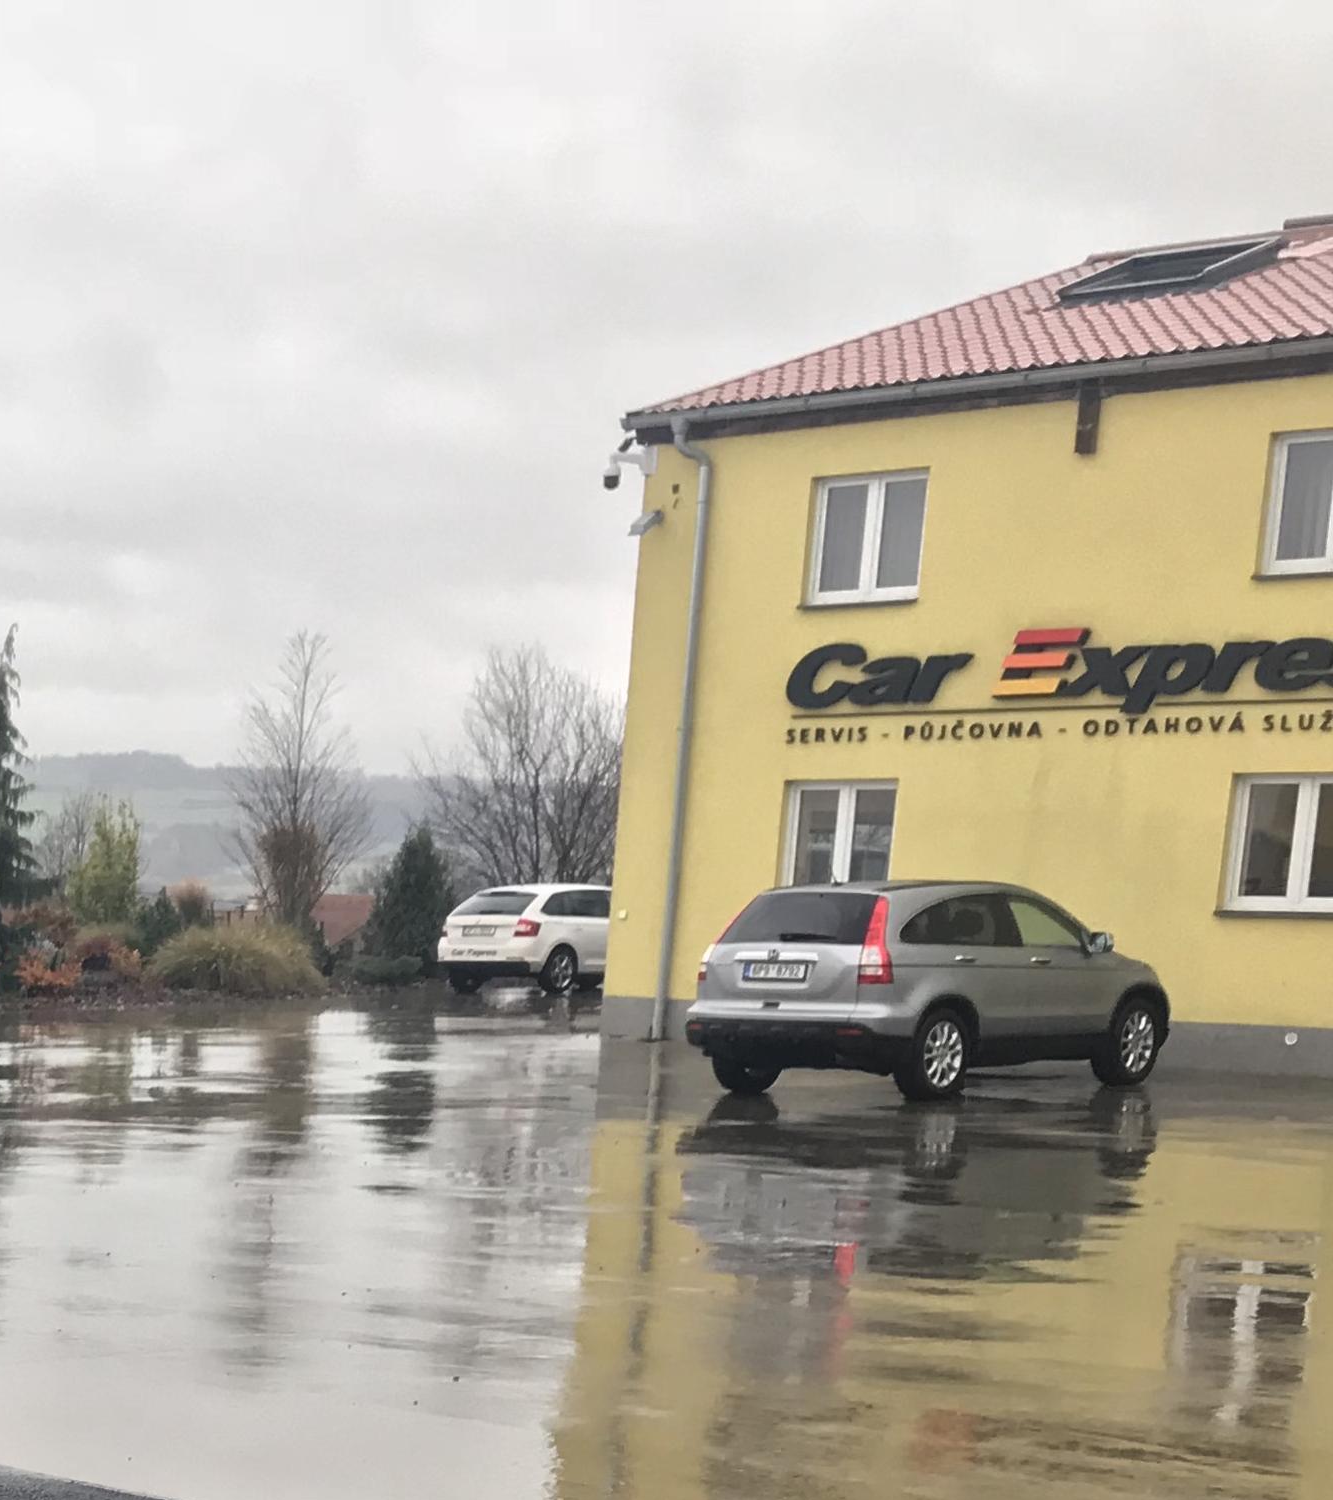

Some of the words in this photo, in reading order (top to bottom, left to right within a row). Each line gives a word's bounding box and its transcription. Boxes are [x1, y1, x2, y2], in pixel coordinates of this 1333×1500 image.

[786, 643, 975, 709] Car
[991, 627, 1333, 714] Expre
[785, 726, 869, 745] SERVIS
[903, 719, 1043, 741] PŮJČOVNA
[1083, 711, 1245, 737] ODTAHOVÁ
